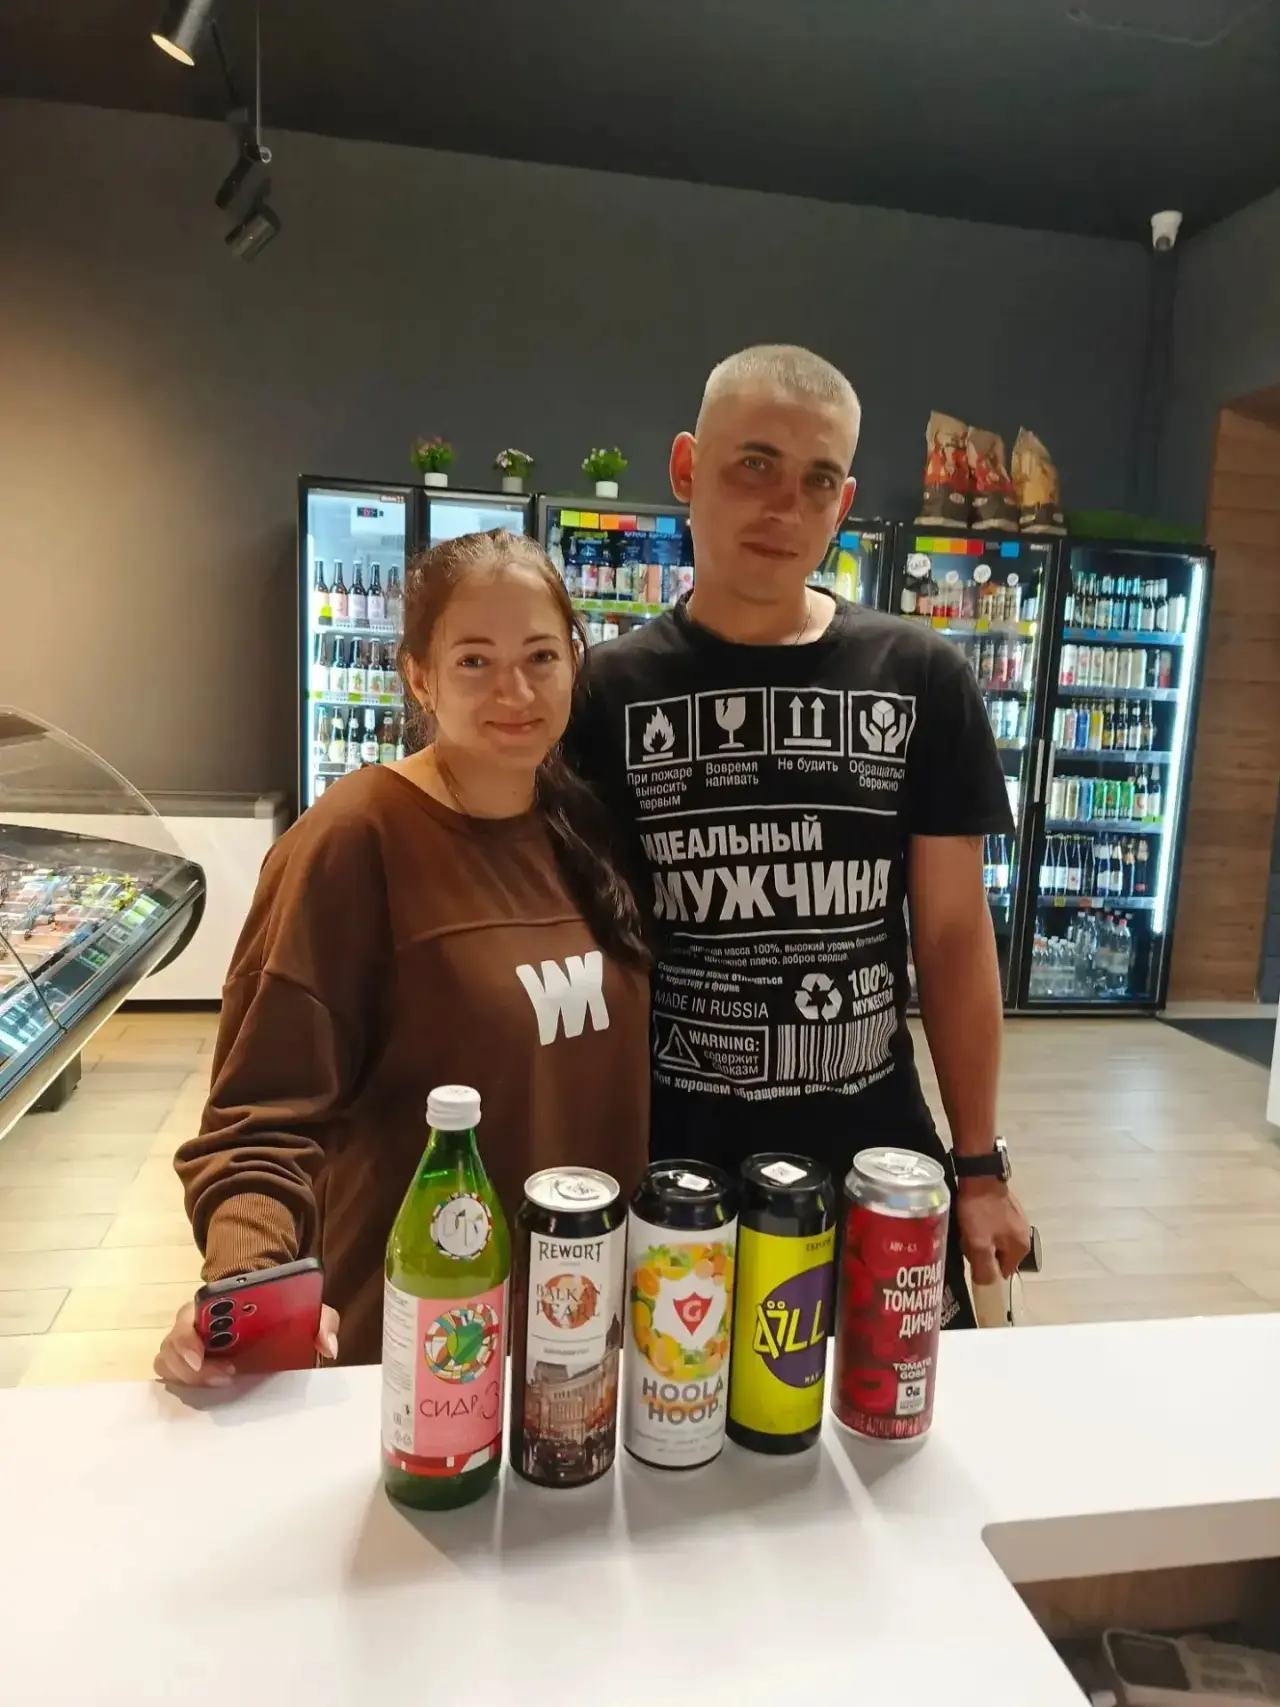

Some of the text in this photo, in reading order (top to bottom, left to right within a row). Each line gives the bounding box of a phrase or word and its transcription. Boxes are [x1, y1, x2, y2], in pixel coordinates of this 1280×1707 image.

[705, 761, 759, 775] Вовремя
[778, 757, 838, 772] Не будить
[627, 766, 693, 786] При пожаре
[705, 774, 759, 787] наливать
[859, 774, 899, 791] бережно
[636, 781, 687, 797] выносить
[640, 796, 681, 811] первым
[640, 814, 823, 865] ИДЕАЛЬНЫЙ
[652, 858, 892, 923] МУЖЧИНА
[848, 960, 896, 998] 100%
[654, 989, 768, 1019] MADE IN RUSSIA
[688, 1030, 760, 1052] WARNING:
[674, 1076, 731, 1095] хорошем
[539, 1241, 604, 1262] REWORT
[642, 1374, 724, 1403] HOOLA
[648, 1397, 719, 1425] HOOP
